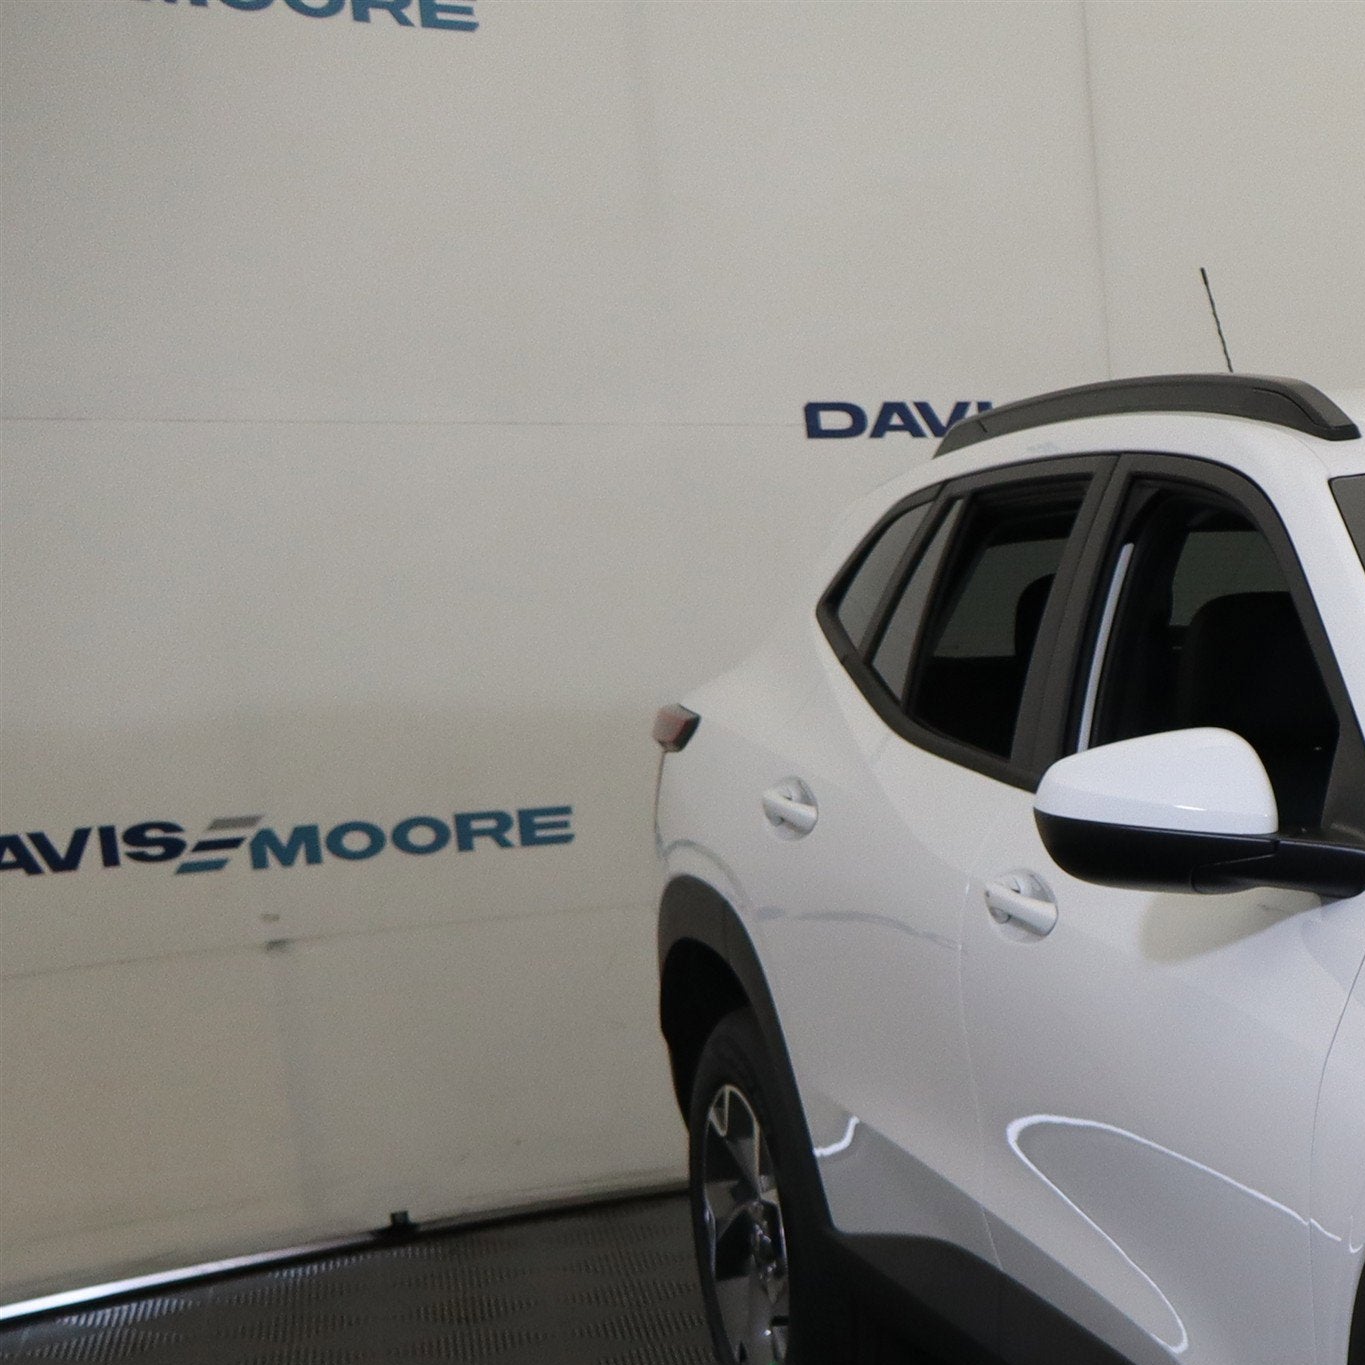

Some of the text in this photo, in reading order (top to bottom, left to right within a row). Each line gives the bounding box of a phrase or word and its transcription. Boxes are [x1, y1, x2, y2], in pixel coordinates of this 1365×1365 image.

[803, 401, 995, 440] DAV
[0, 805, 575, 877] AVIS MOORE
